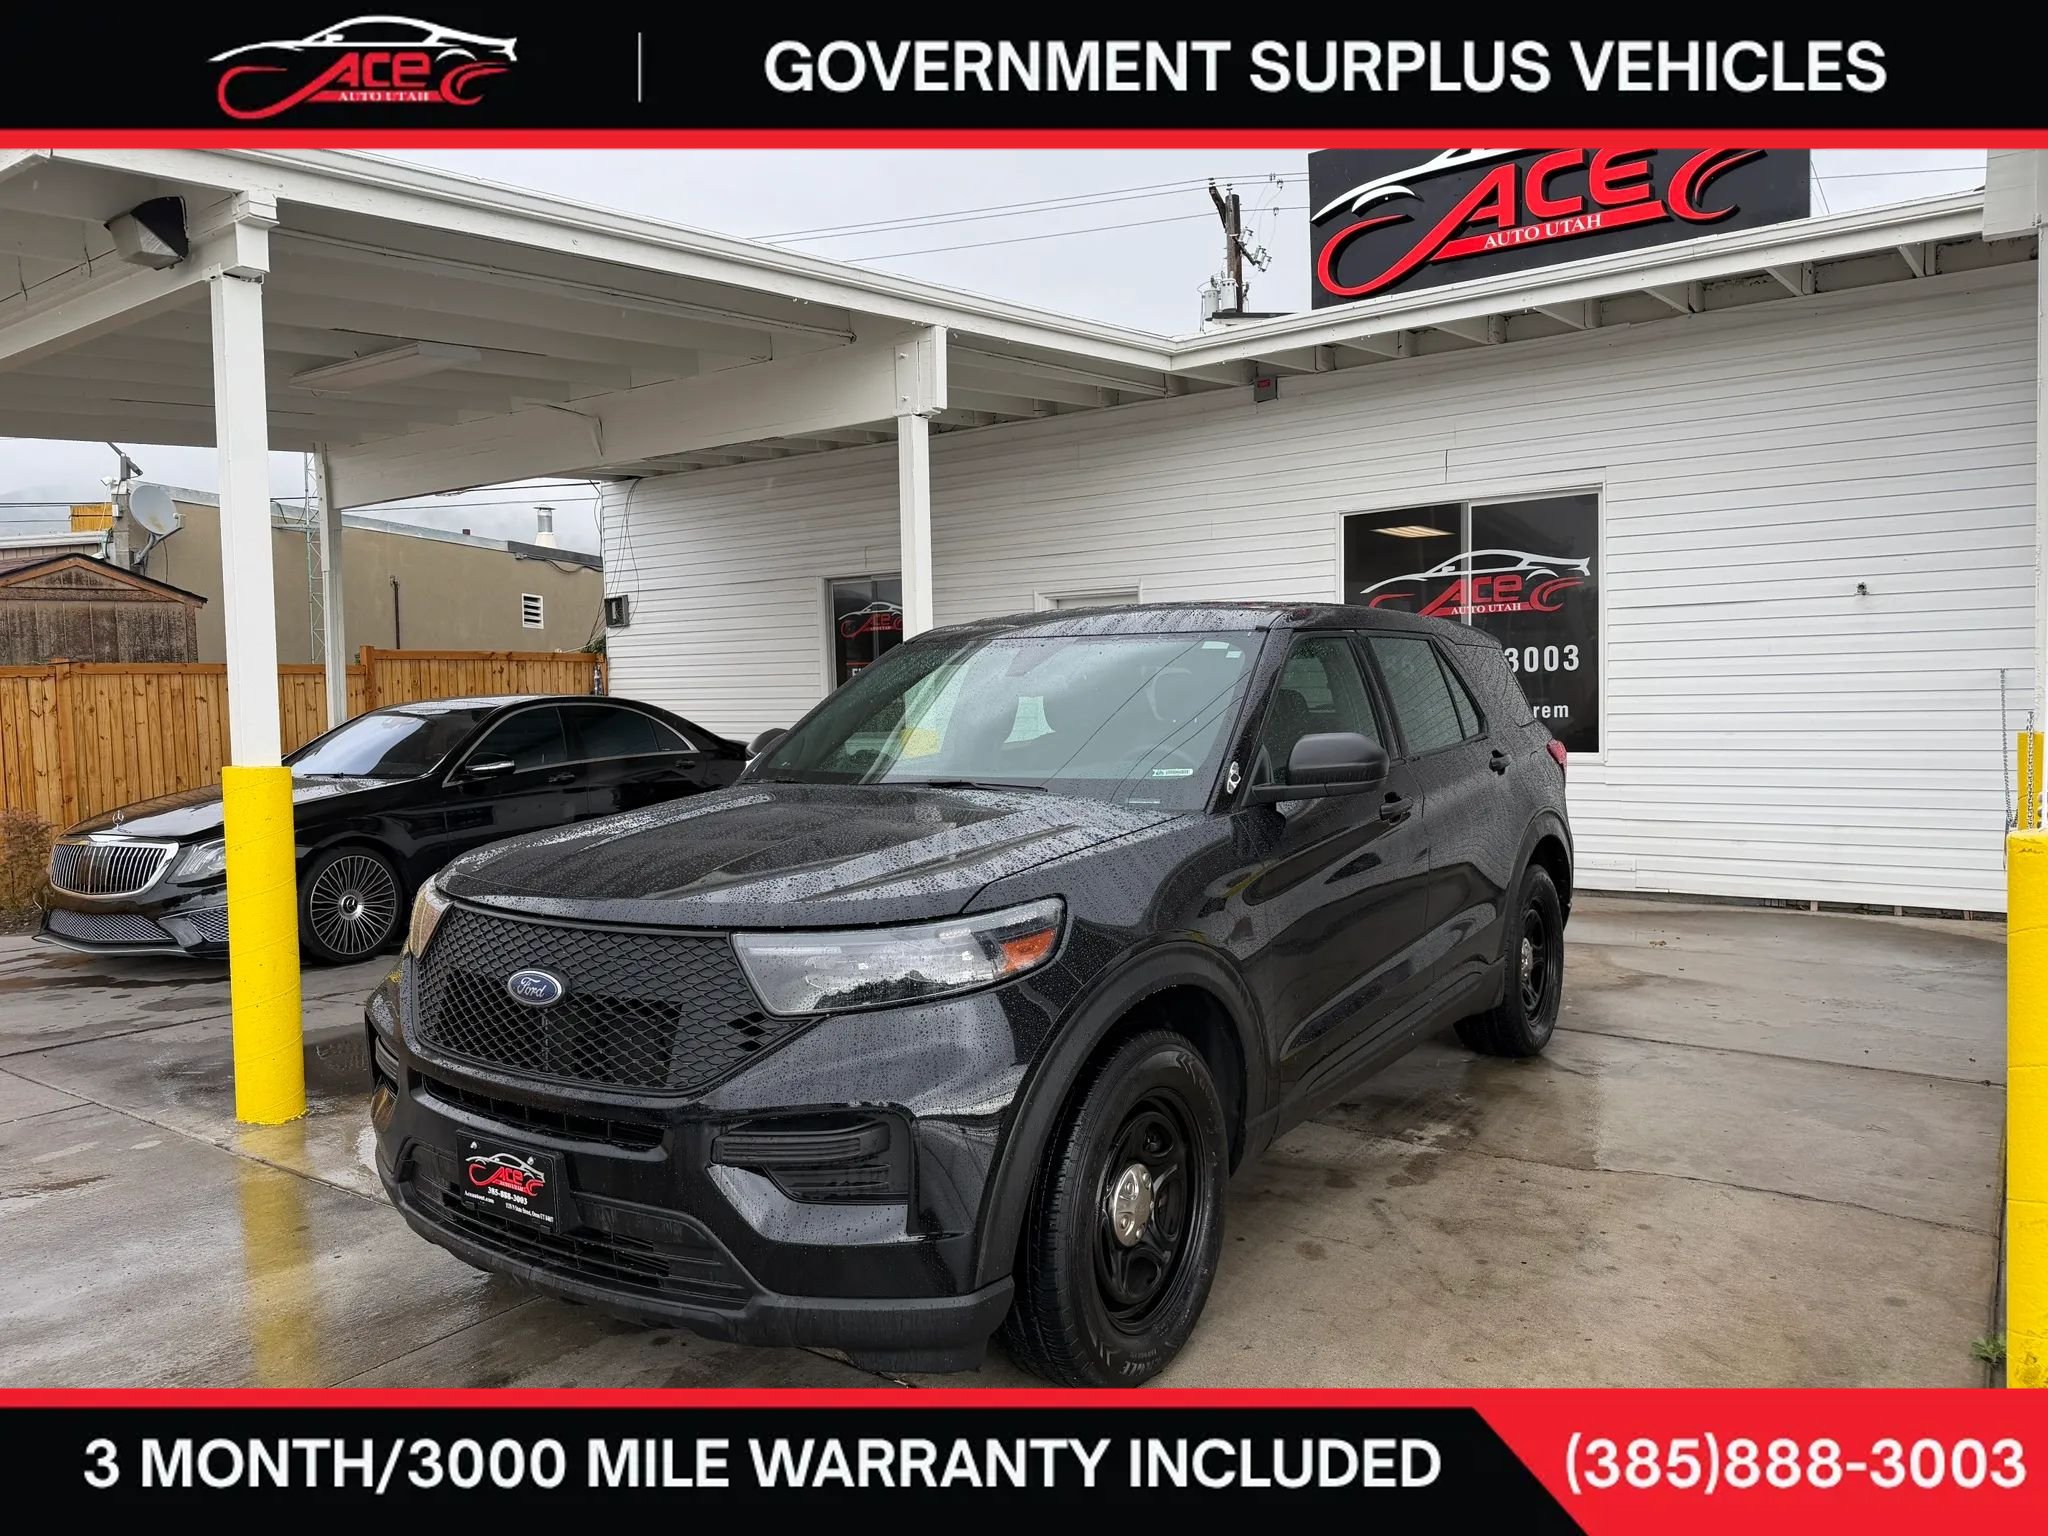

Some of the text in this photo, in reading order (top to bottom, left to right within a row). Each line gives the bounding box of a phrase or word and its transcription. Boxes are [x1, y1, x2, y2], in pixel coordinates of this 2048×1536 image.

[1484, 214, 1602, 249] AUTO UTAH
[1451, 602, 1522, 616] AUTO UTAH
[517, 977, 547, 998] Ford
